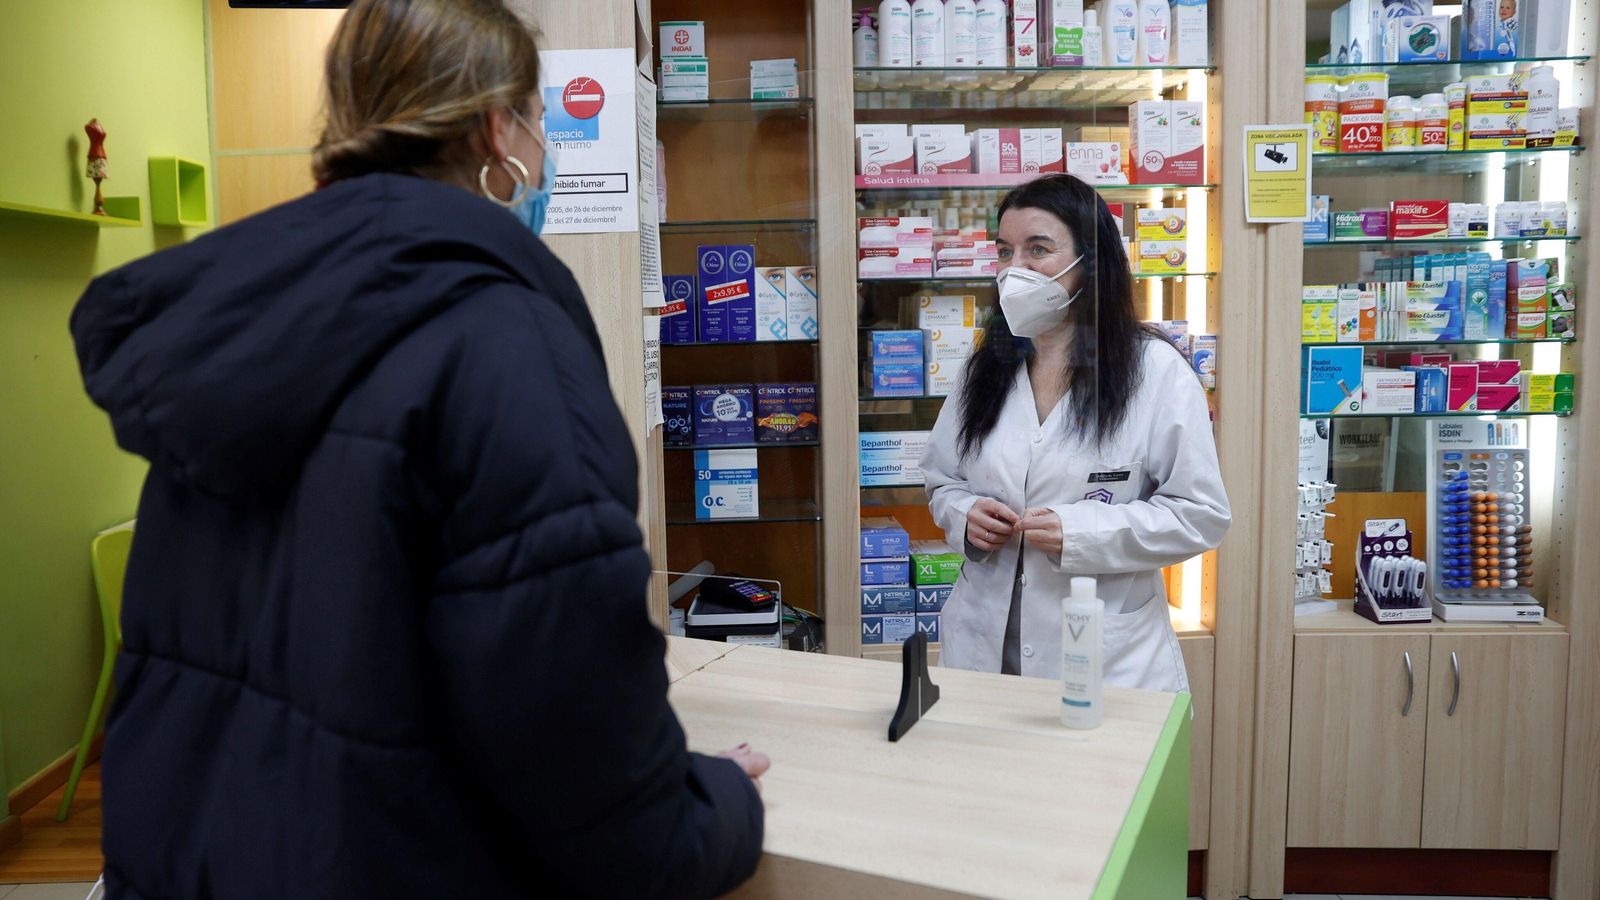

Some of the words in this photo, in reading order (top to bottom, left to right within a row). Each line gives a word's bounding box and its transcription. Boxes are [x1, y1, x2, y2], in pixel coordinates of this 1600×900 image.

[547, 129, 584, 141] espacio
[552, 141, 562, 150] in
[563, 141, 592, 150] humo
[1070, 148, 1103, 160] enna
[580, 179, 606, 188] fumar
[897, 176, 930, 184] íntima
[1396, 206, 1428, 214] maxlife
[1336, 214, 1366, 222] Hidroxil
[758, 387, 786, 395] CONTROL
[787, 386, 815, 394] CONTROL
[861, 439, 902, 448] Bepanthol
[1300, 434, 1316, 444] teel
[862, 464, 902, 473] Bepanthol
[698, 470, 711, 480] 50
[704, 496, 726, 507] O.C.
[864, 537, 873, 547] L
[864, 565, 874, 574] L
[920, 565, 936, 575] XL
[864, 593, 882, 605] M
[919, 591, 936, 603] M
[1065, 614, 1091, 622] VICHY
[863, 622, 881, 634] M
[918, 620, 936, 632] M
